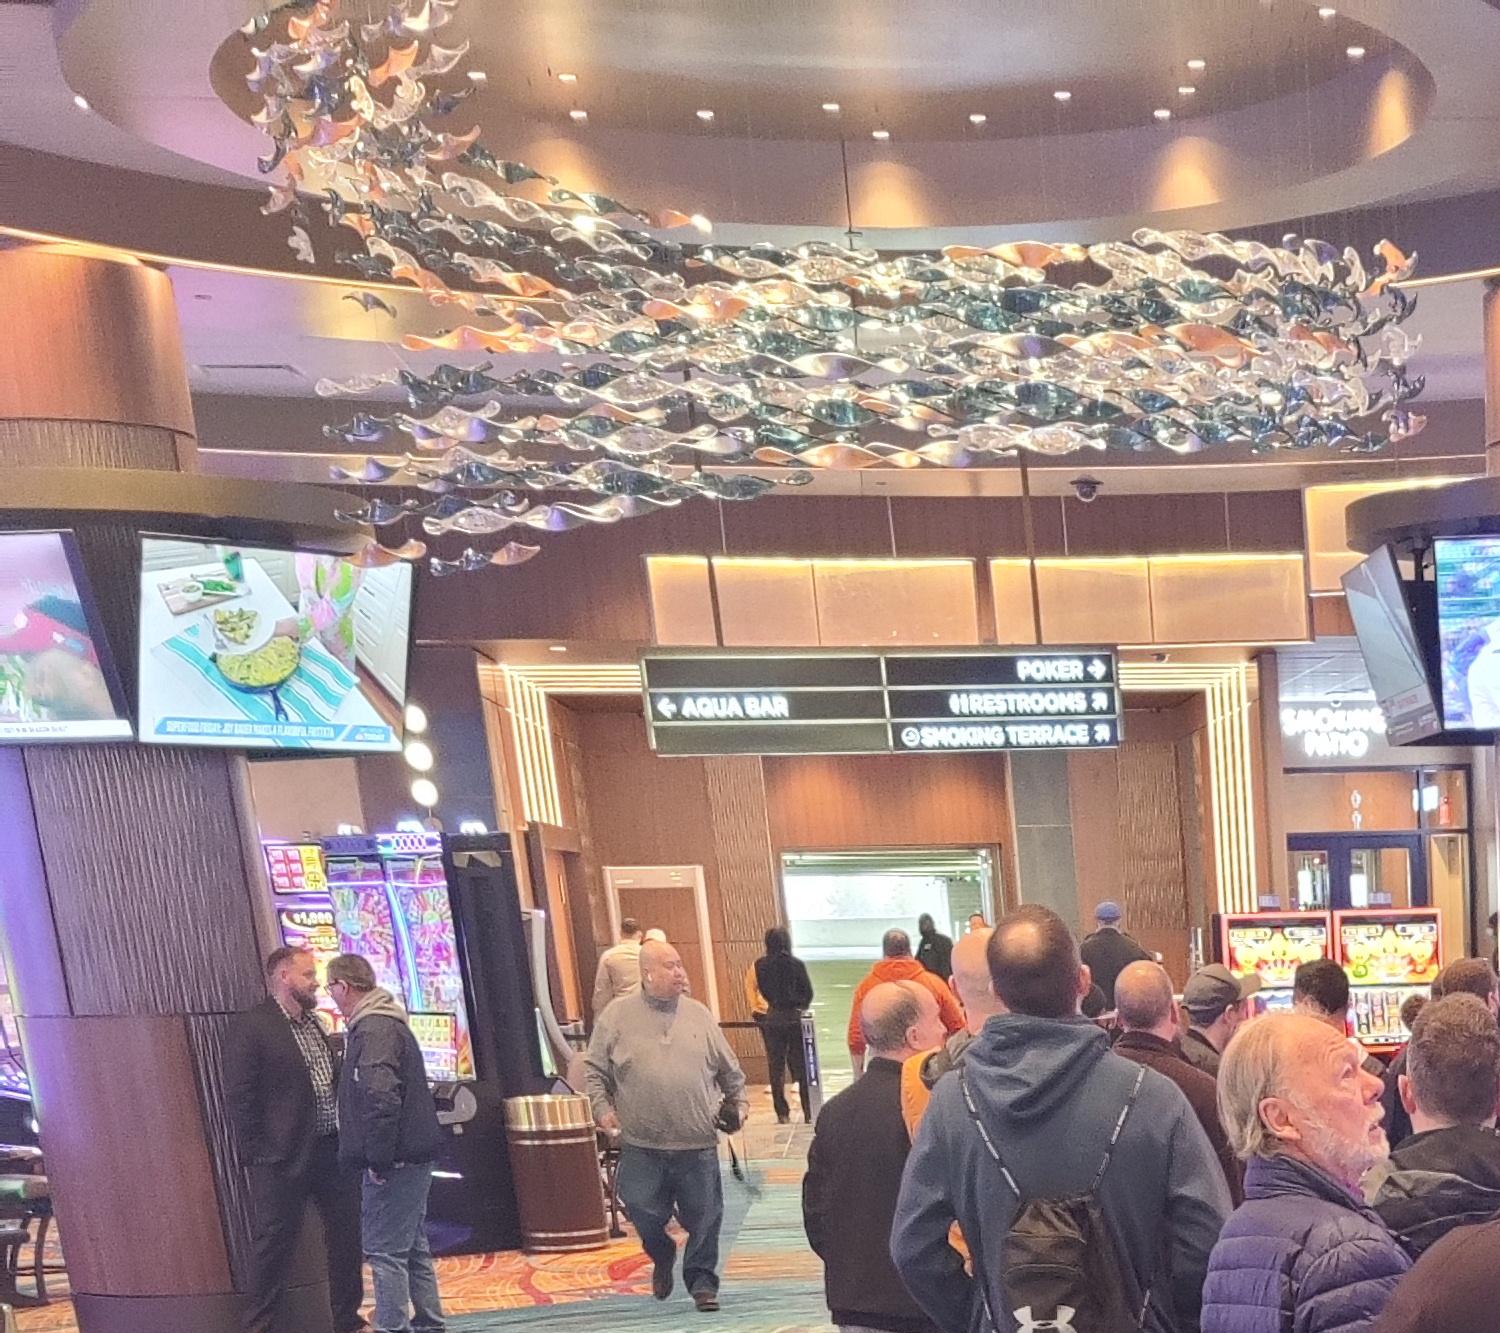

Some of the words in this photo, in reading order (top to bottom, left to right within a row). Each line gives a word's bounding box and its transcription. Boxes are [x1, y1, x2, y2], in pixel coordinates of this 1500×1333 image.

[1016, 659, 1084, 681] POKER
[681, 697, 744, 718] AQUA
[744, 695, 789, 718] BAR
[968, 692, 1087, 714] RESTROOMS
[1280, 708, 1387, 736] SMOKING
[919, 725, 1005, 747] SMOKING
[1006, 724, 1089, 745] TERRACE
